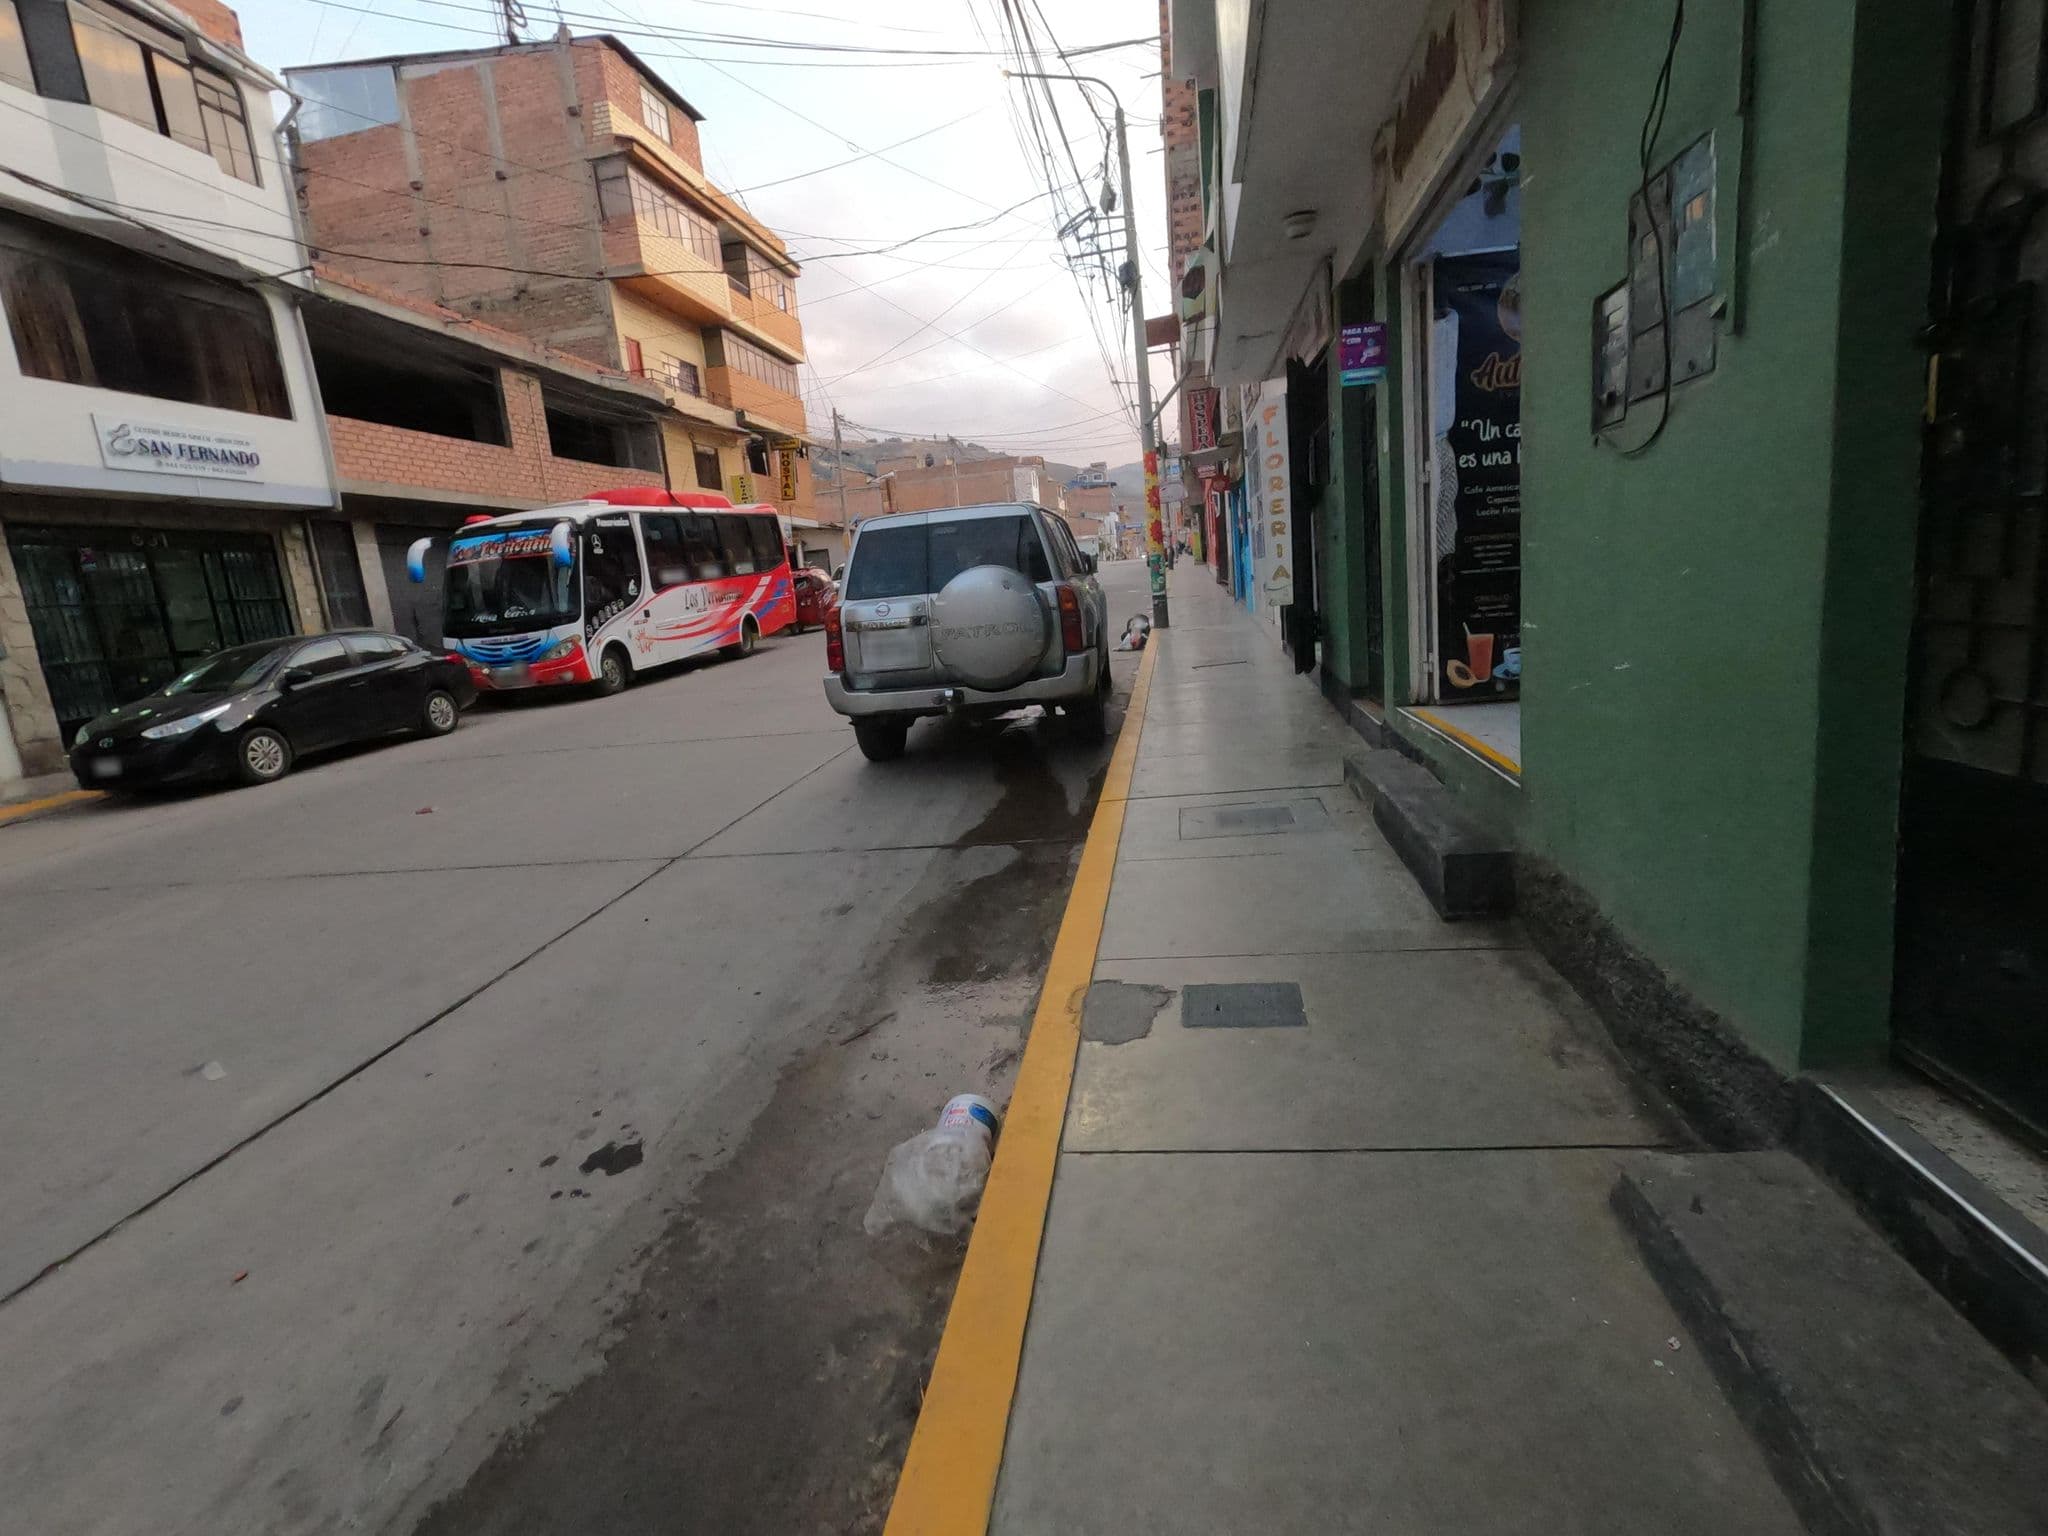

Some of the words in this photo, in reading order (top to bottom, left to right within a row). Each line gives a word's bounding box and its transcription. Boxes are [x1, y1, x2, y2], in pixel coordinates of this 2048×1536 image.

[1342, 328, 1361, 336] PAGA
[138, 438, 172, 456] SAN
[178, 443, 260, 467] FERNANDO
[1459, 452, 1477, 468] es
[1482, 450, 1512, 467] una
[781, 452, 792, 497] HOSTAL
[1263, 406, 1290, 581] FLORERIA
[941, 621, 1035, 641] PATROL
